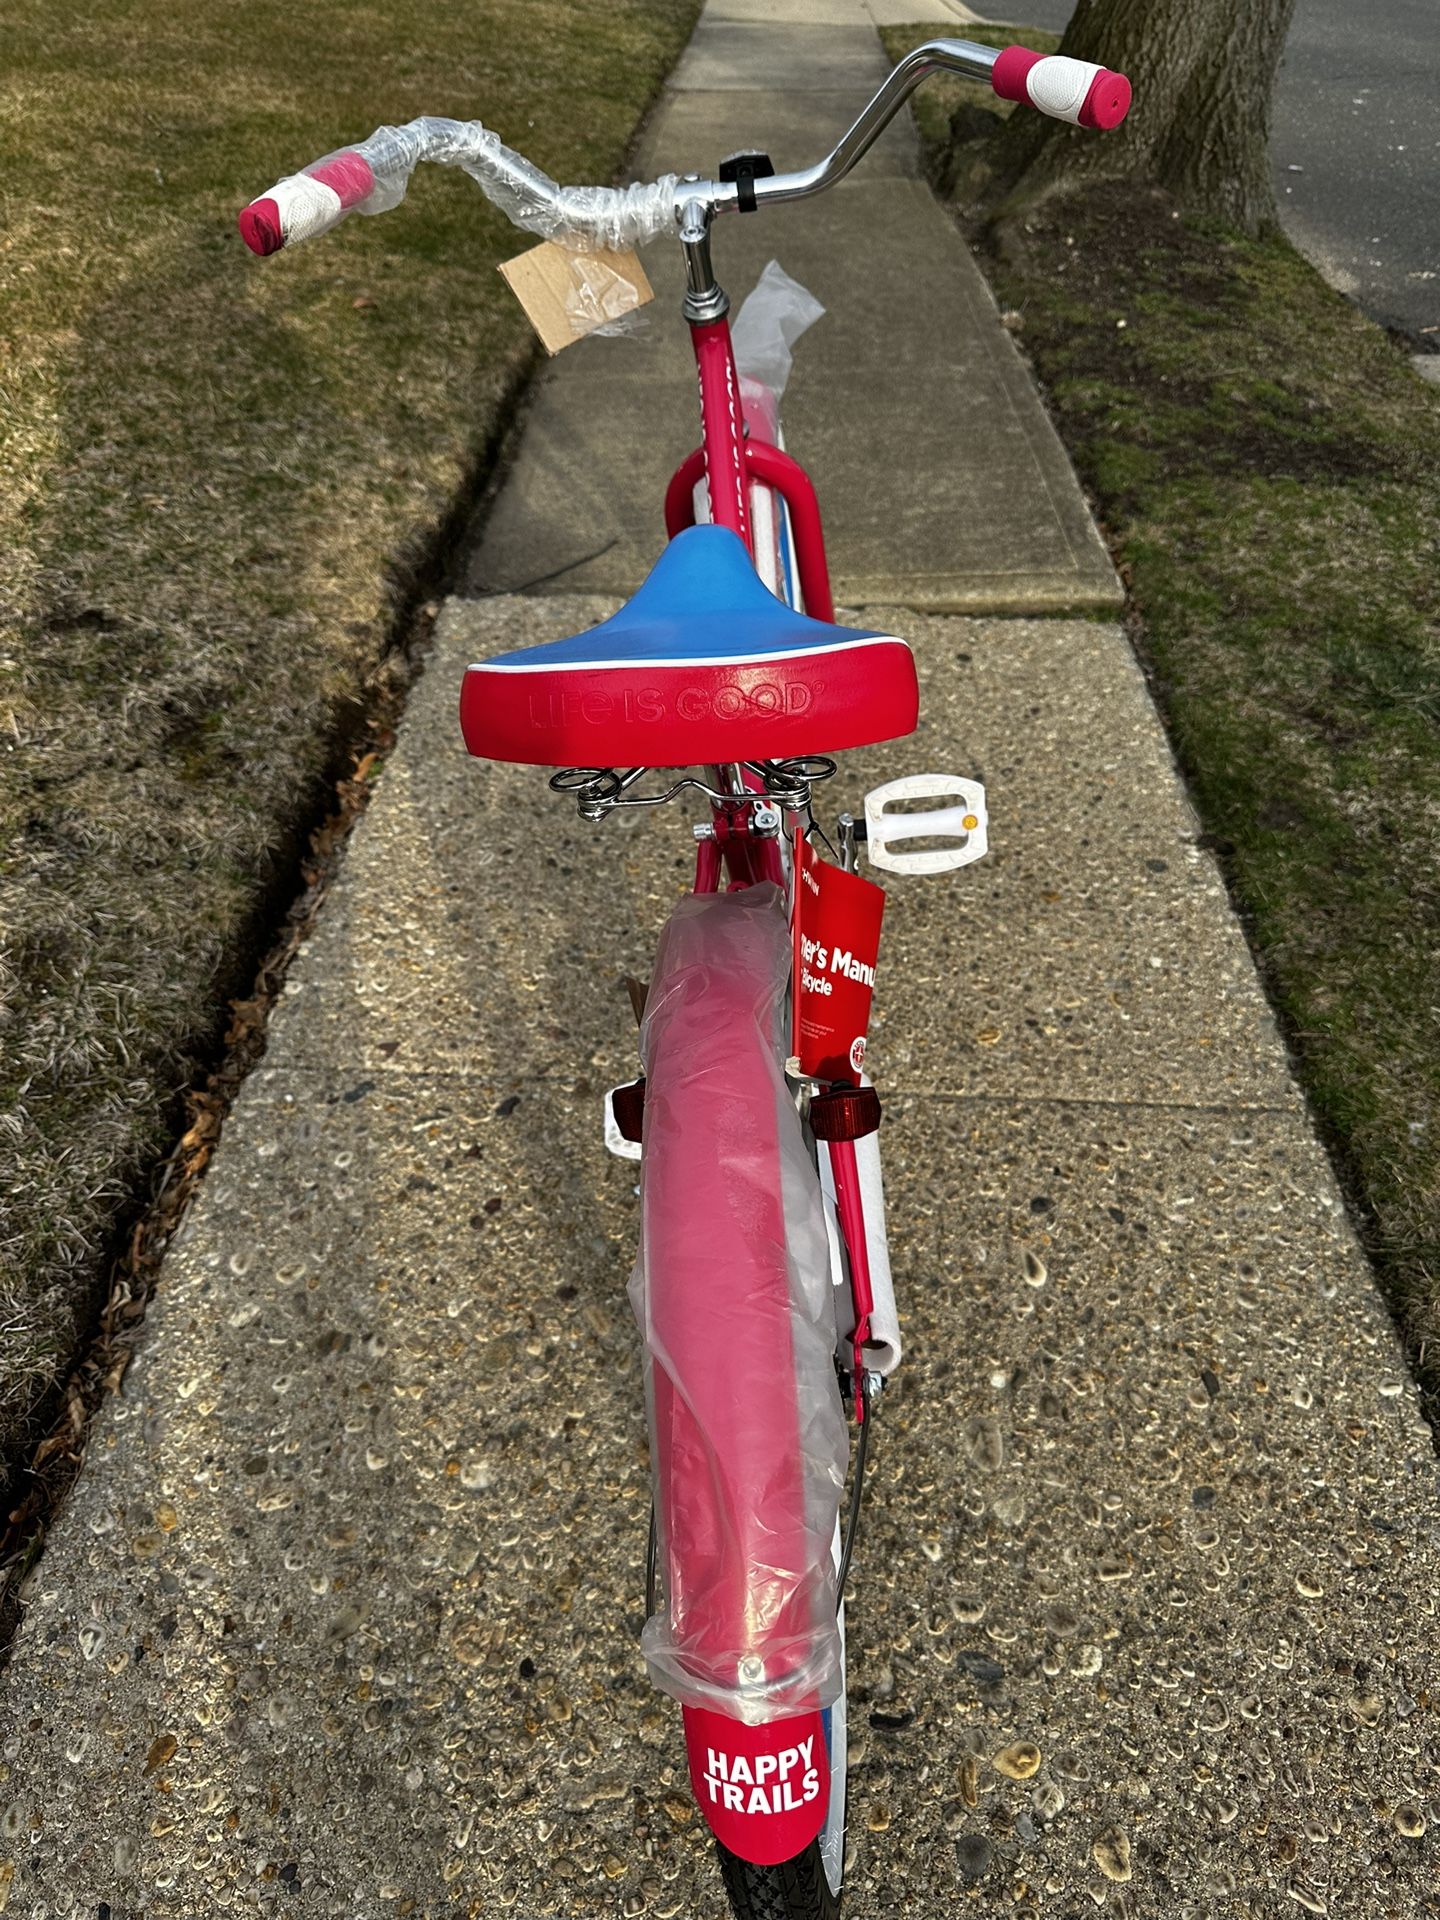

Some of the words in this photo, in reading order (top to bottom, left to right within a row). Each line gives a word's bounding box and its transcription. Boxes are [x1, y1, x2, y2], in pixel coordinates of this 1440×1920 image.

[624, 688, 666, 723] IS
[801, 933, 828, 969] ner's
[831, 947, 876, 988] Manu
[707, 1734, 814, 1785] HAPPY
[703, 1768, 820, 1815] TRAILS
